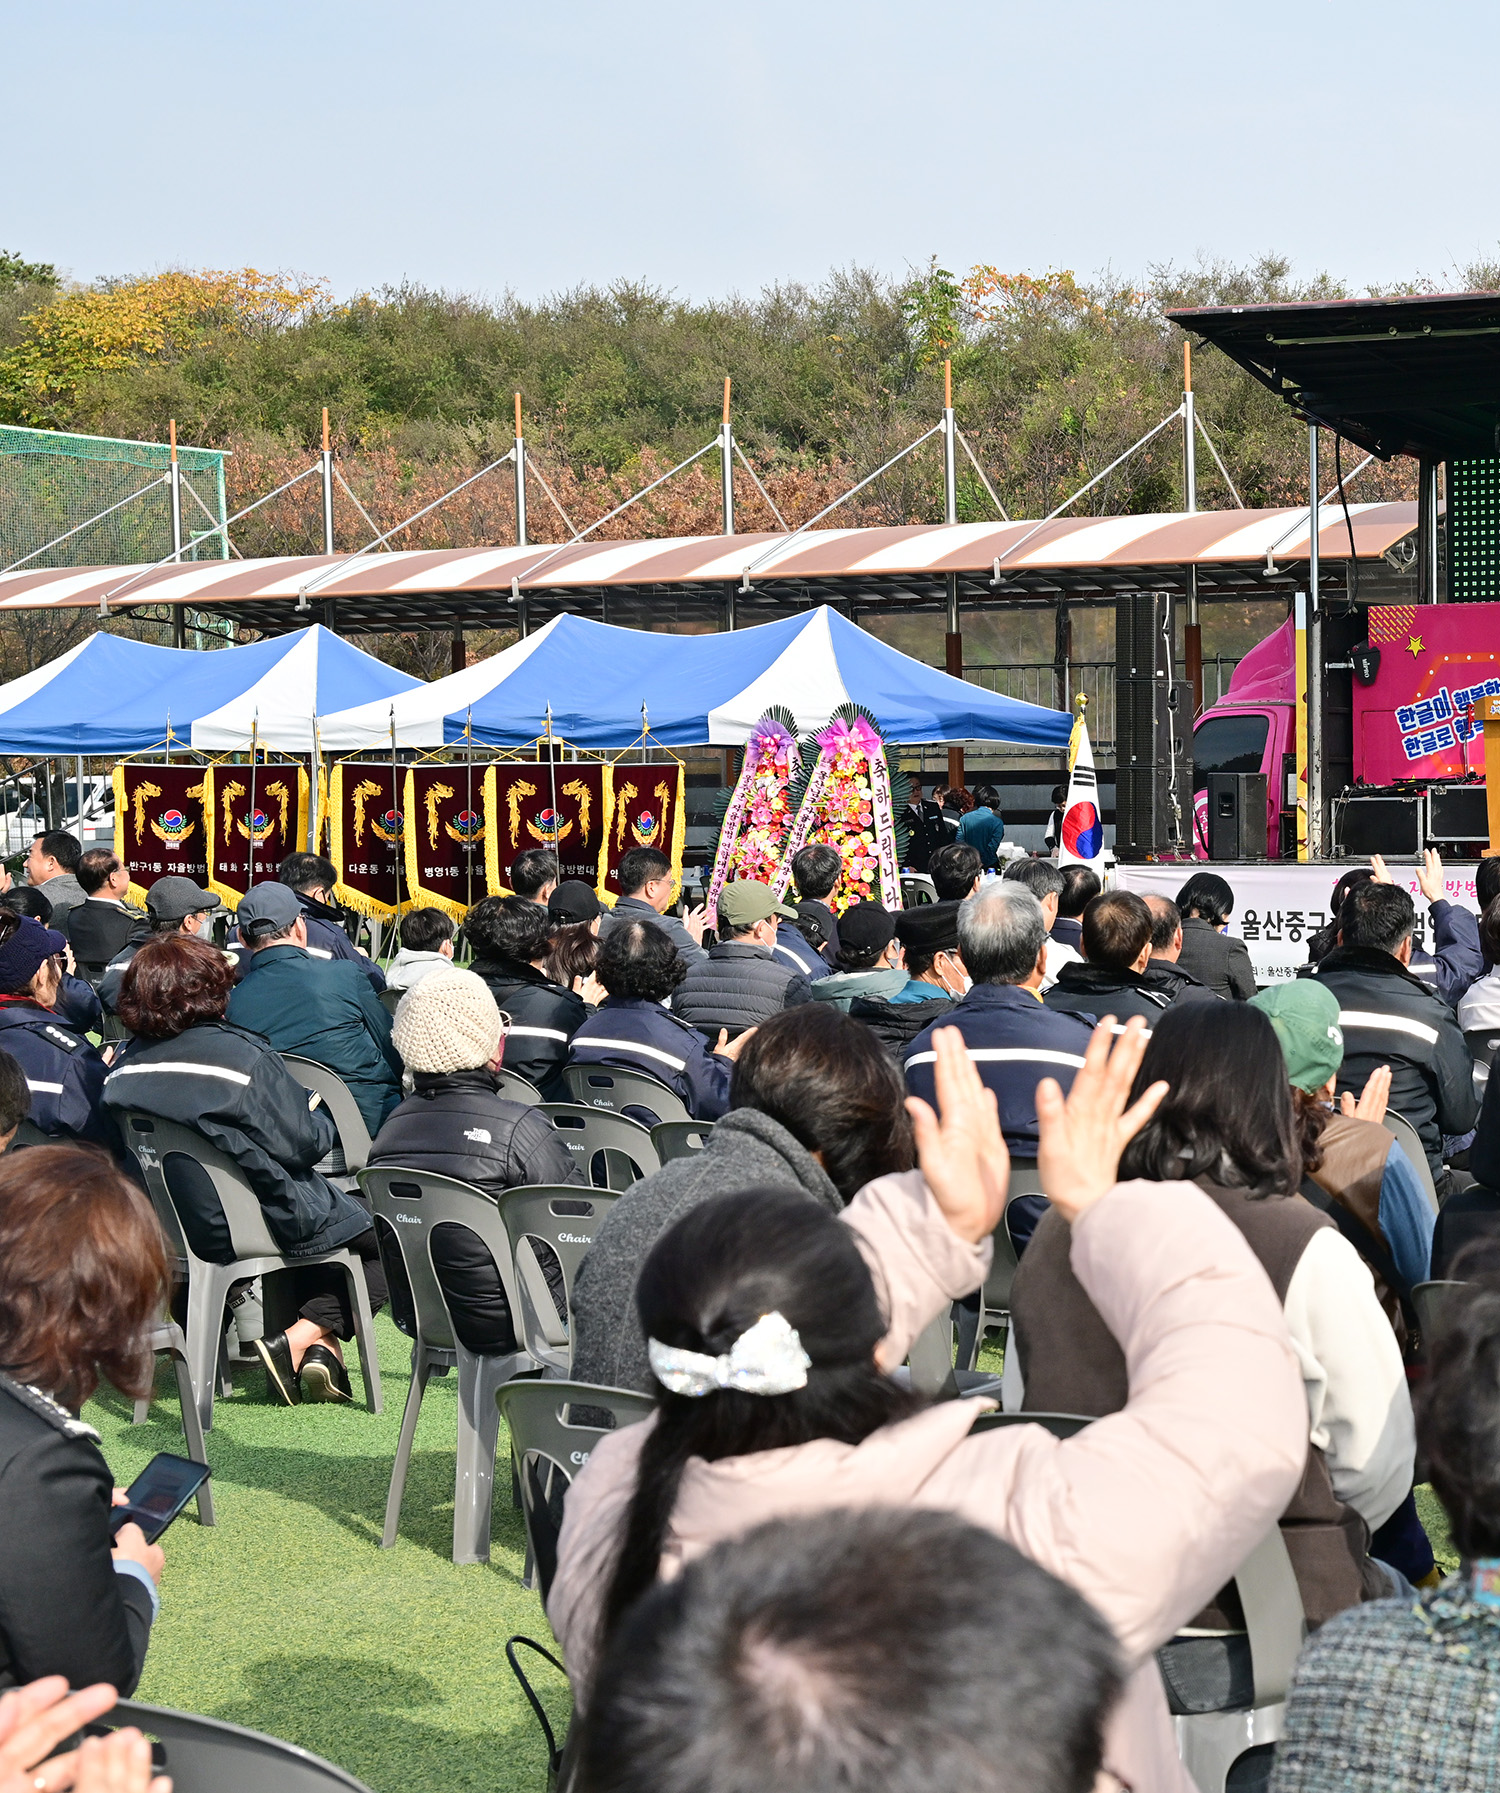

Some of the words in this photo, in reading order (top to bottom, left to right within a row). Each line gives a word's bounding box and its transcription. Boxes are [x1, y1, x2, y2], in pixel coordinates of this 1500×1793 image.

[1396, 688, 1451, 732] 한글이
[1404, 726, 1454, 759] 한글로
[129, 861, 162, 873] 반구1동
[167, 862, 206, 874] 자율방범
[348, 863, 379, 875] 다운동
[424, 866, 460, 878] 병영1동
[560, 863, 595, 876] 율방범대
[593, 1098, 614, 1107] Chair
[138, 1144, 156, 1154] Chair
[396, 1213, 422, 1224] Chair
[557, 1232, 592, 1243] Chair
